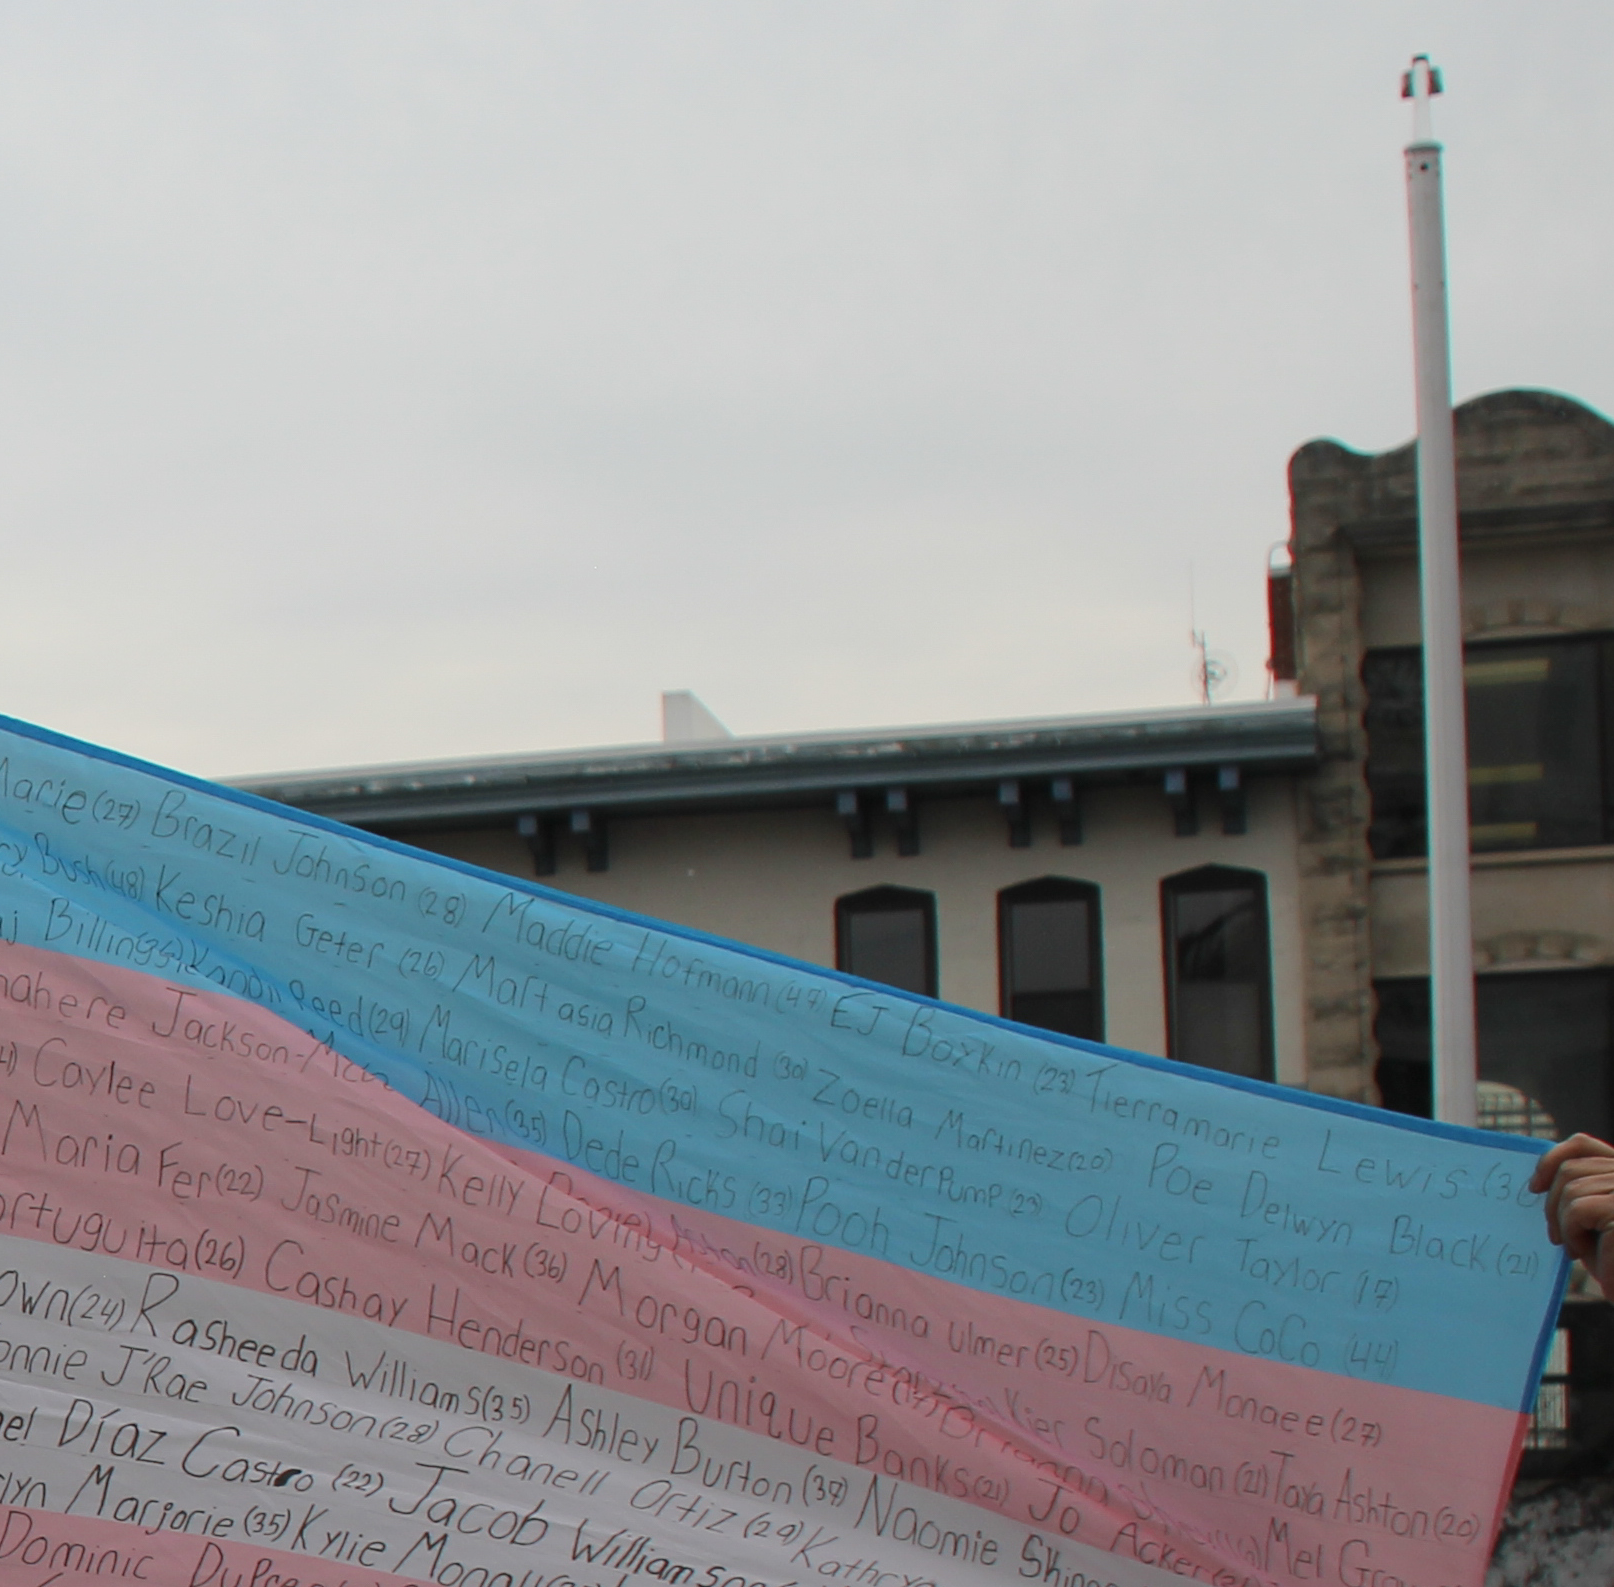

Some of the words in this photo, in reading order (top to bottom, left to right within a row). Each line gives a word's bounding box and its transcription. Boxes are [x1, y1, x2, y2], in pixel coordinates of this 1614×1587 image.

[34, 1038, 156, 1109] Caylee
[2, 1099, 140, 1176] Maria
[427, 1284, 604, 1385] Henderson
[685, 1358, 835, 1456] Unique
